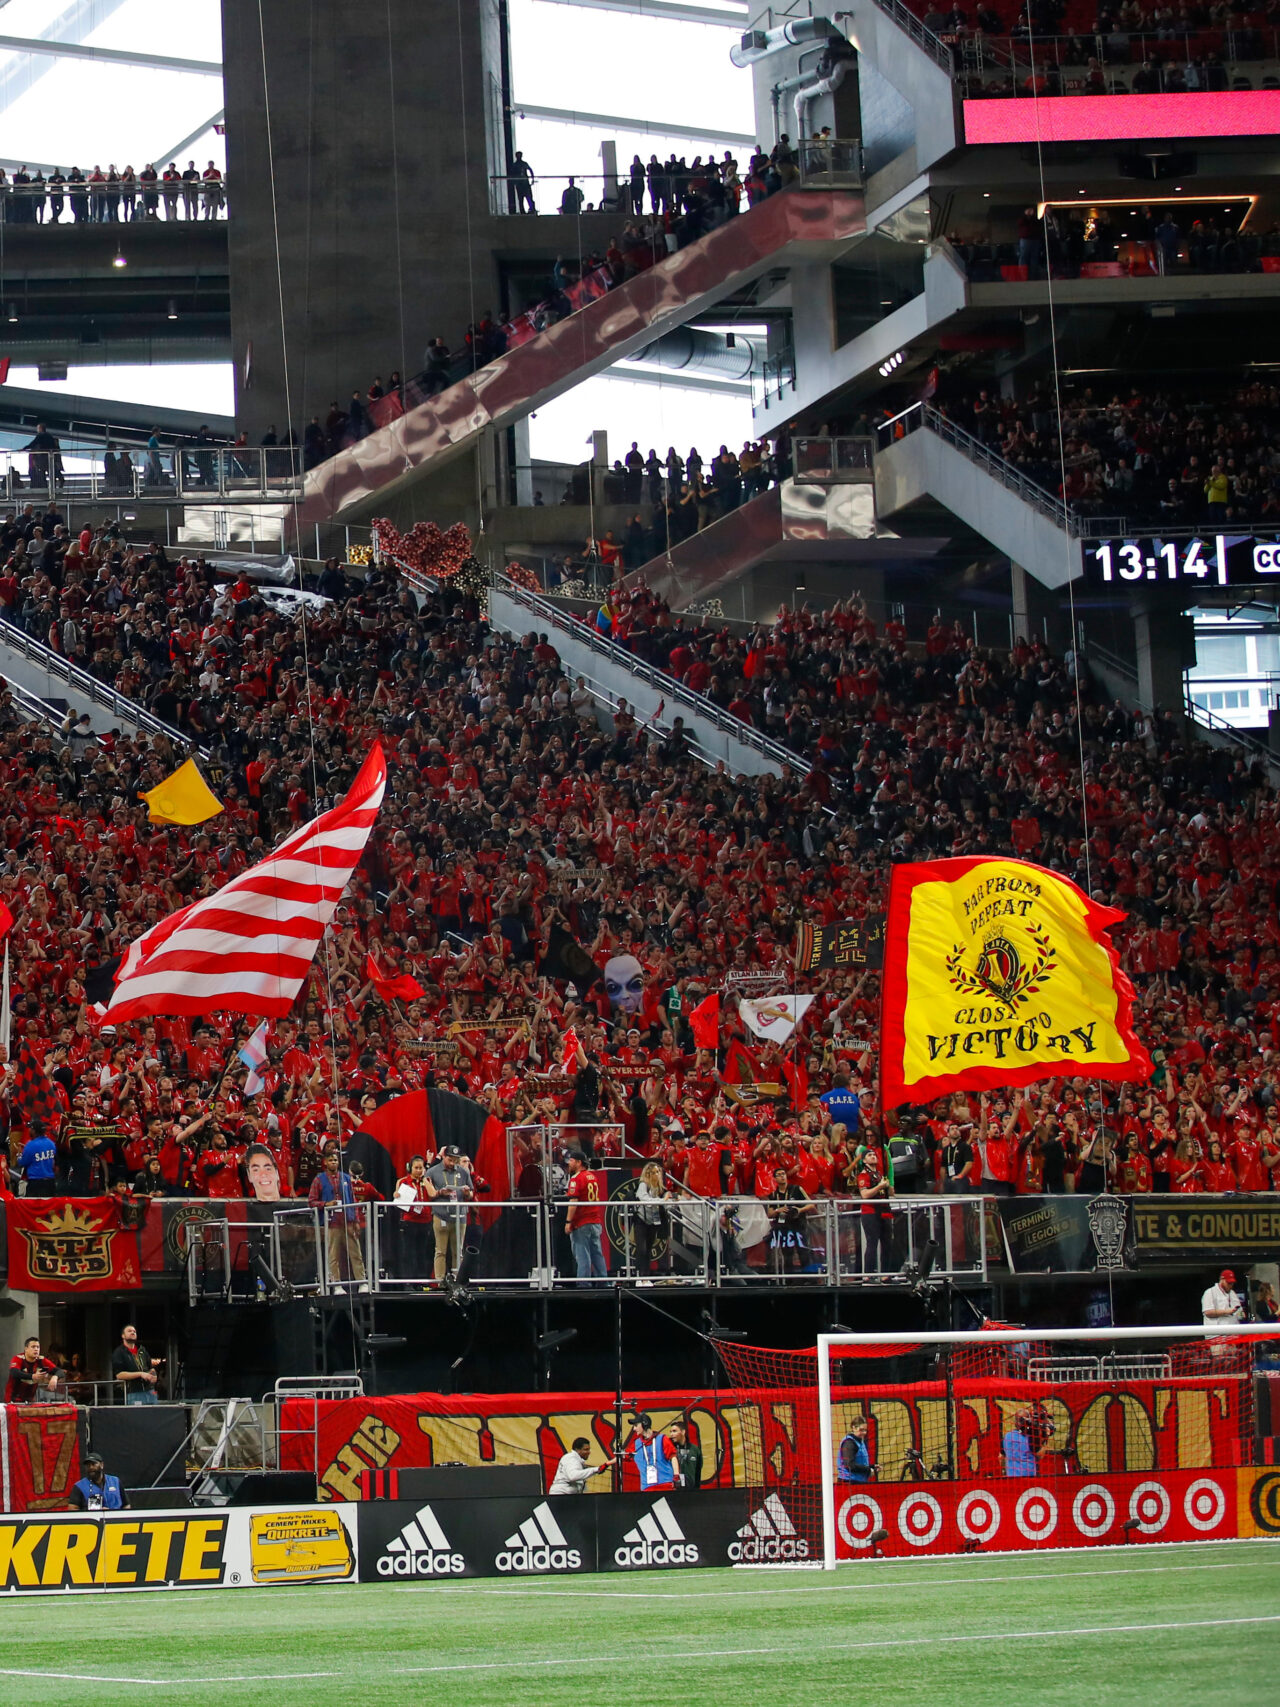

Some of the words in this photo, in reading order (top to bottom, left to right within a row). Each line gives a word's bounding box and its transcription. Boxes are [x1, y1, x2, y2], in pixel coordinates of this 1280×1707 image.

[1095, 542, 1209, 581] 13:14
[986, 876, 1042, 897] FROM
[970, 898, 1033, 936] DEFEAT
[730, 970, 758, 979] ATLANTA
[758, 969, 783, 978] UNITED
[1025, 1011, 1052, 1030] TO
[926, 1021, 1097, 1061] VICTORY
[1094, 1201, 1120, 1209] TERMINUS
[1011, 1207, 1057, 1233] TERMINUS
[1166, 1214, 1183, 1237] &
[1187, 1214, 1280, 1239] CONQUER
[36, 1232, 104, 1257] ATL
[1027, 1224, 1061, 1245] LEGION
[36, 1256, 107, 1274] UTD
[20, 1419, 78, 1496] 17
[265, 1520, 298, 1528] CEMENT
[266, 1527, 330, 1541] QUIKRETE
[495, 1545, 582, 1571] adidas
[614, 1539, 699, 1567] adidas
[727, 1535, 809, 1561] adidas
[285, 1564, 320, 1573] QUIKRETE
[376, 1552, 466, 1576] adidas
